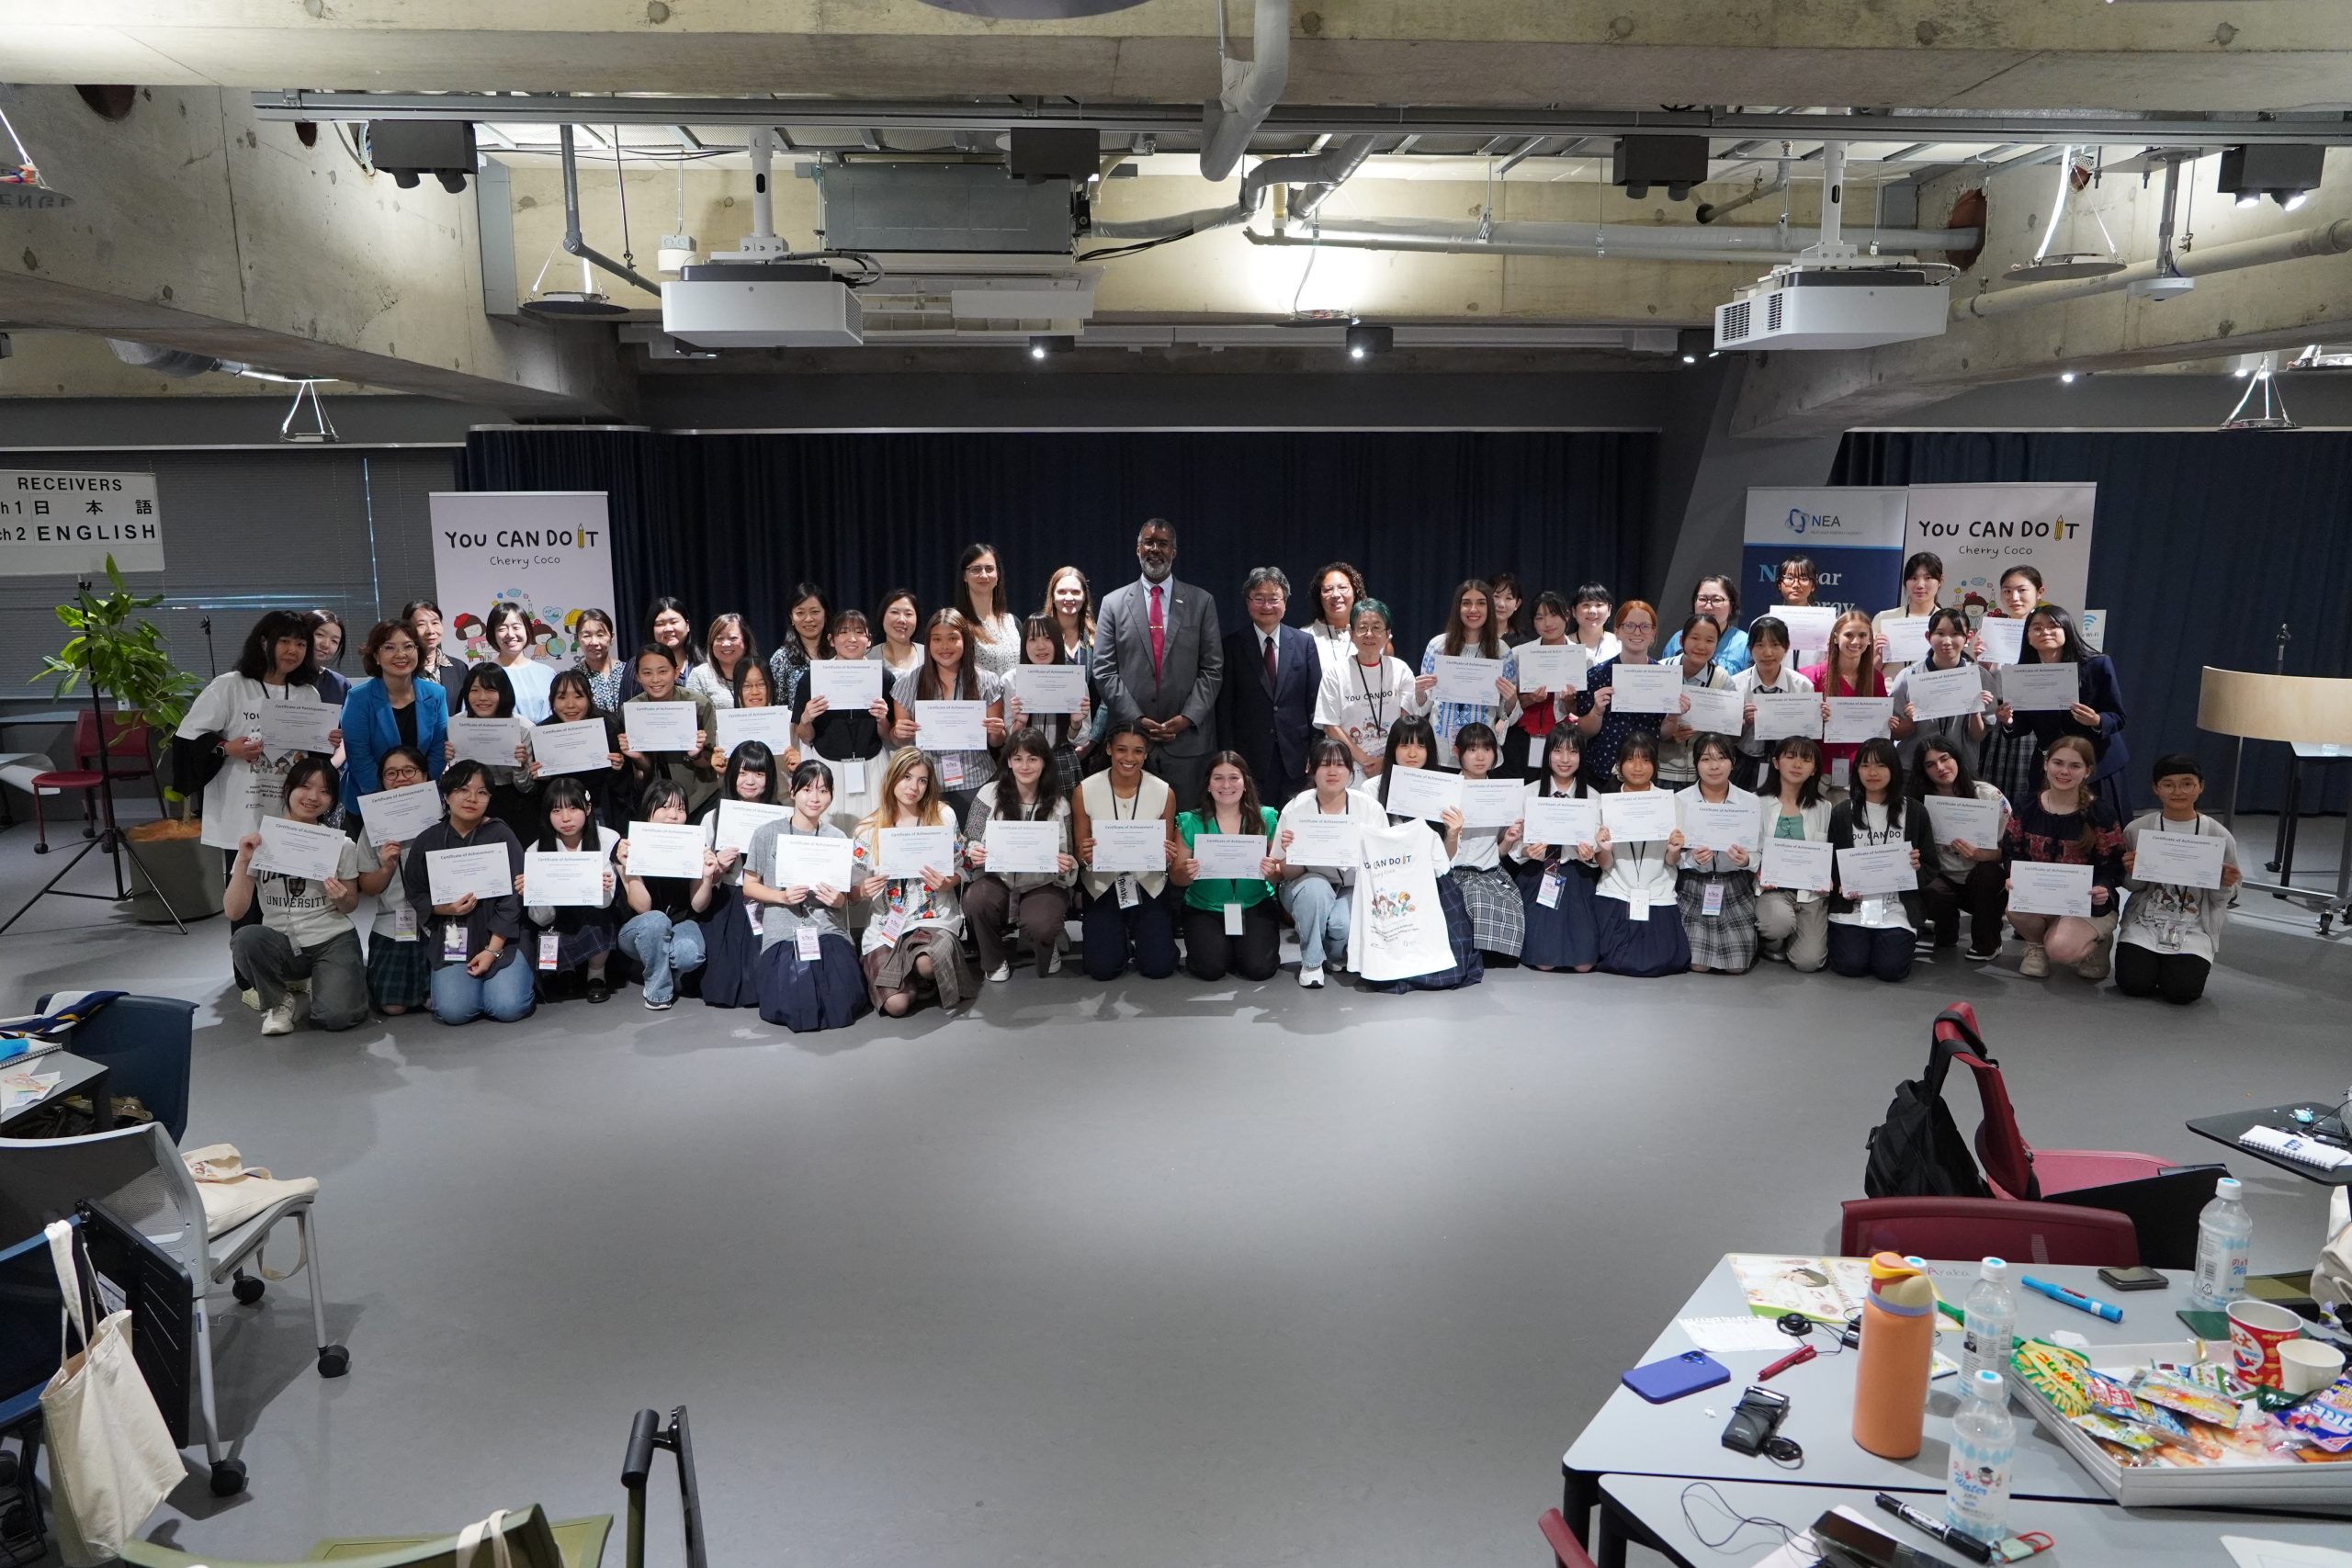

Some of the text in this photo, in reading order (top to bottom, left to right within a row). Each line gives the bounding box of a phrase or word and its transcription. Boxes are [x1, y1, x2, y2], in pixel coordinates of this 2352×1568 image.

[17, 477, 123, 491] RECEIVERS
[0, 501, 22, 514] h 1
[1811, 514, 1841, 527] NEA
[16, 526, 27, 541] 2
[37, 524, 156, 542] ENGLISH
[1918, 521, 1960, 537] YOU
[1969, 521, 2015, 538] CAN
[2021, 520, 2050, 538] DO
[444, 531, 487, 548] YOU
[496, 530, 540, 547] CAN
[547, 529, 573, 547] DO
[1959, 545, 2033, 559] Cherry Coco
[490, 555, 560, 570] Cherry Coco
[1344, 690, 1393, 703] YOU CAN DO
[1852, 832, 1864, 840] OU
[1889, 829, 1902, 839] DO
[1388, 857, 1402, 865] DO
[266, 895, 328, 908] UNIVERSITY
[1954, 1473, 1988, 1495] Water
